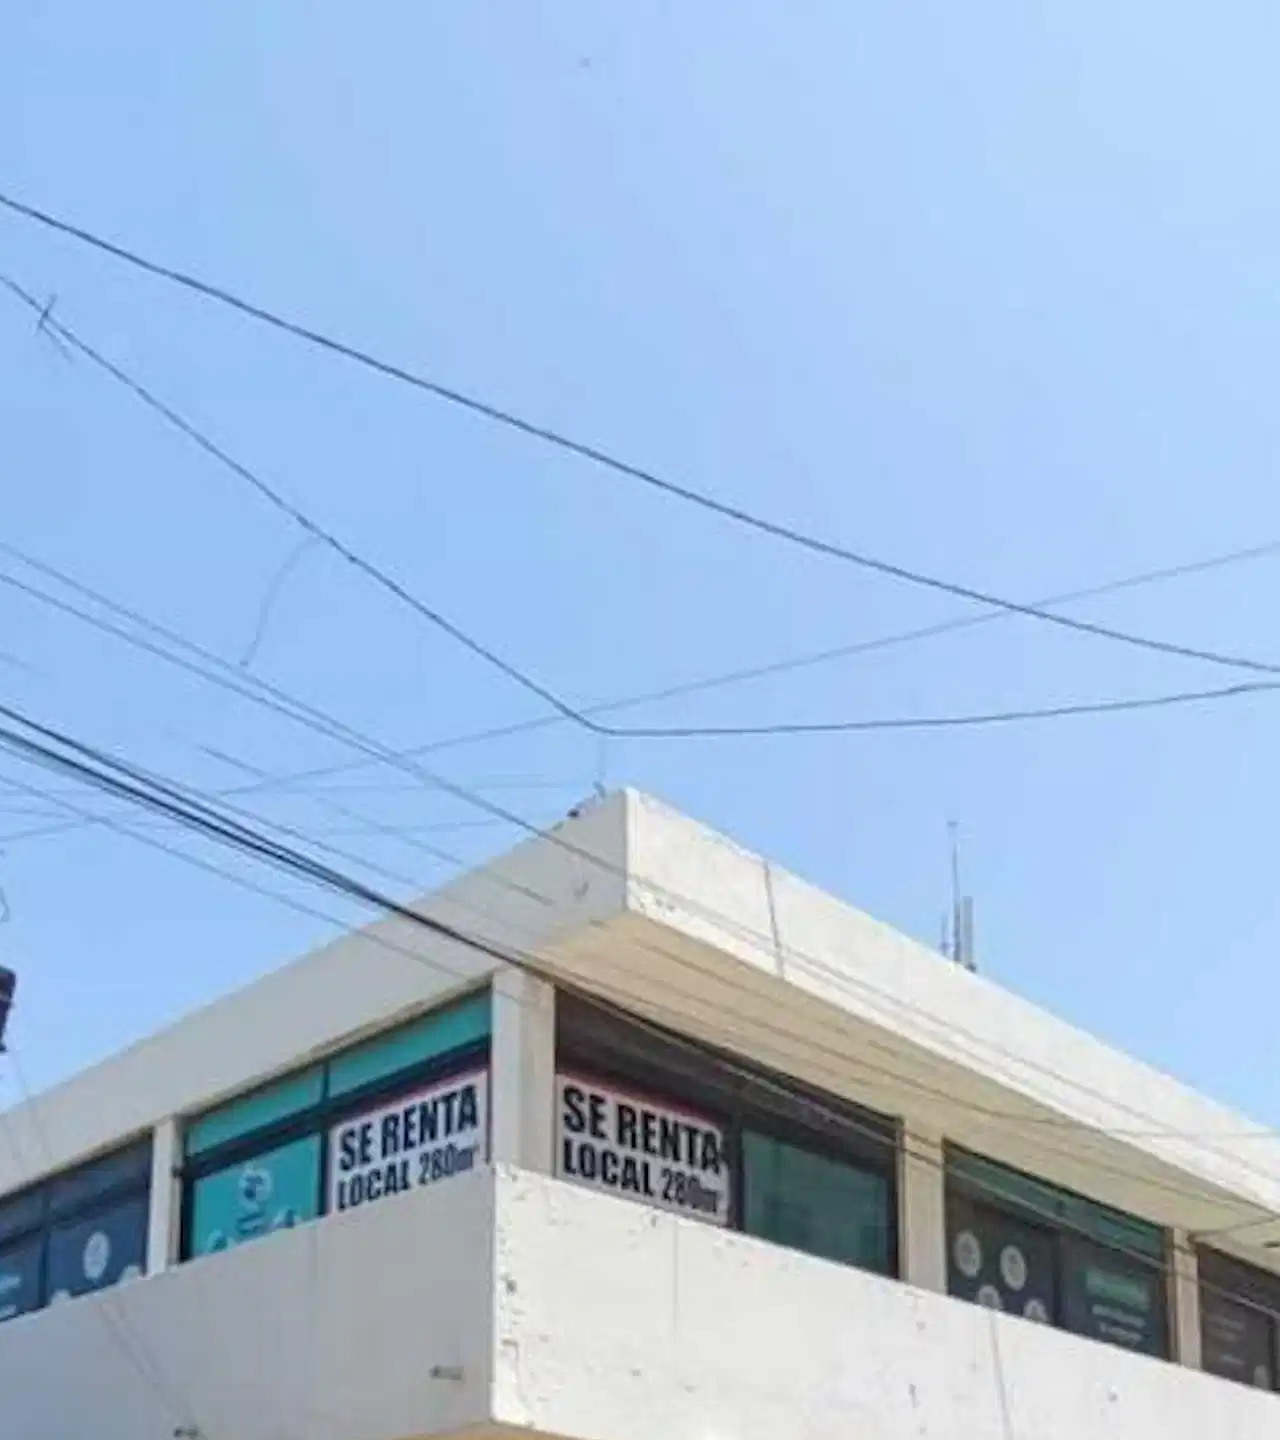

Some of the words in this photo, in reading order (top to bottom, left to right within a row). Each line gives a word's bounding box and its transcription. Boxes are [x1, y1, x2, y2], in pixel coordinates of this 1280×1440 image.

[339, 1122, 372, 1171] SE
[381, 1084, 477, 1158] RENTA
[564, 1084, 606, 1140] SE
[618, 1103, 719, 1175] RENTA
[337, 1159, 411, 1212] LOCAL
[563, 1137, 654, 1197] LOCAL
